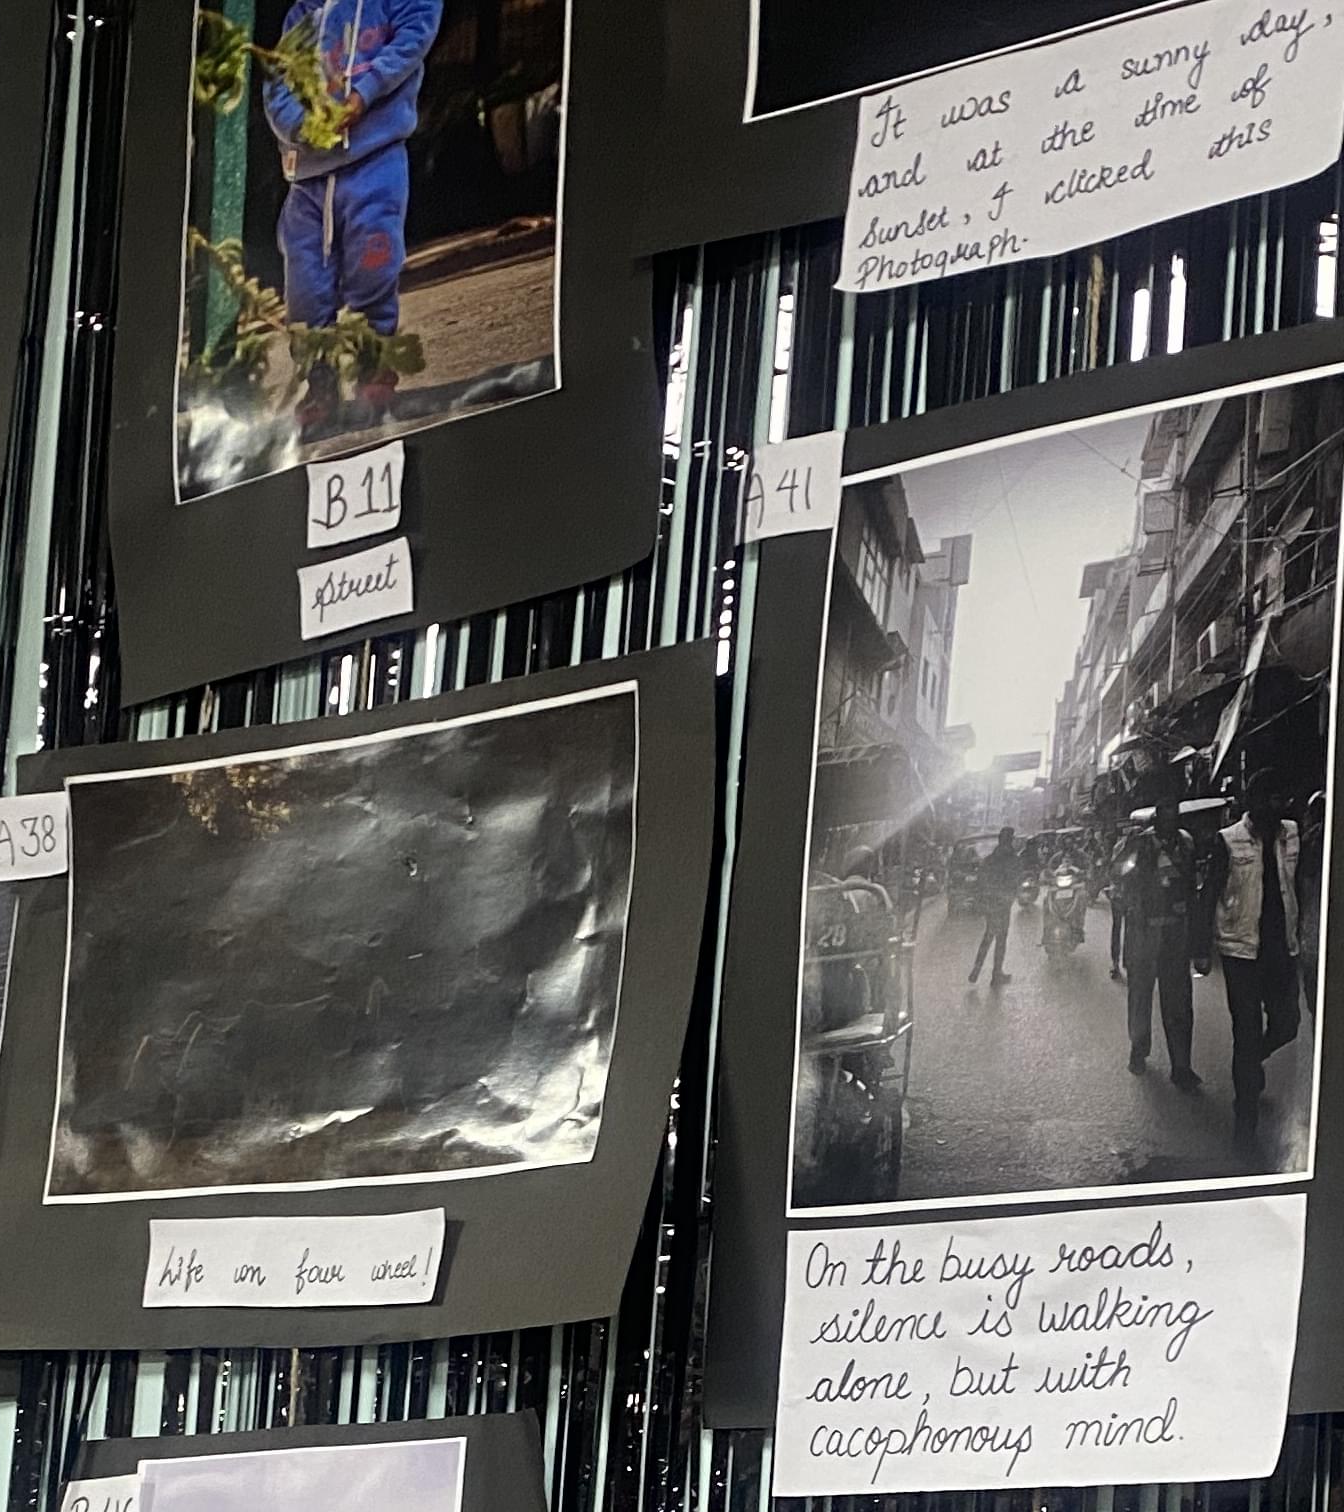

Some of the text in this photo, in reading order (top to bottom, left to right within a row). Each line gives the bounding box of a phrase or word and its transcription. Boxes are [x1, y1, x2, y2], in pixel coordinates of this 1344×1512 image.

[858, 63, 1272, 197] and at the time of
[870, 95, 907, 148] It
[941, 91, 1011, 128] was
[1055, 69, 1085, 98] a
[1121, 41, 1210, 89] sunny
[1045, 149, 1155, 204] clicked
[312, 461, 399, 529] B11
[312, 553, 399, 623] Street
[158, 1246, 346, 1295] Life on four
[806, 1220, 1192, 1310] On the busy roads,
[810, 1286, 1214, 1362] silence is walking
[807, 1346, 1132, 1406] alone, but with
[809, 1397, 1184, 1485] cacophonous mind.
